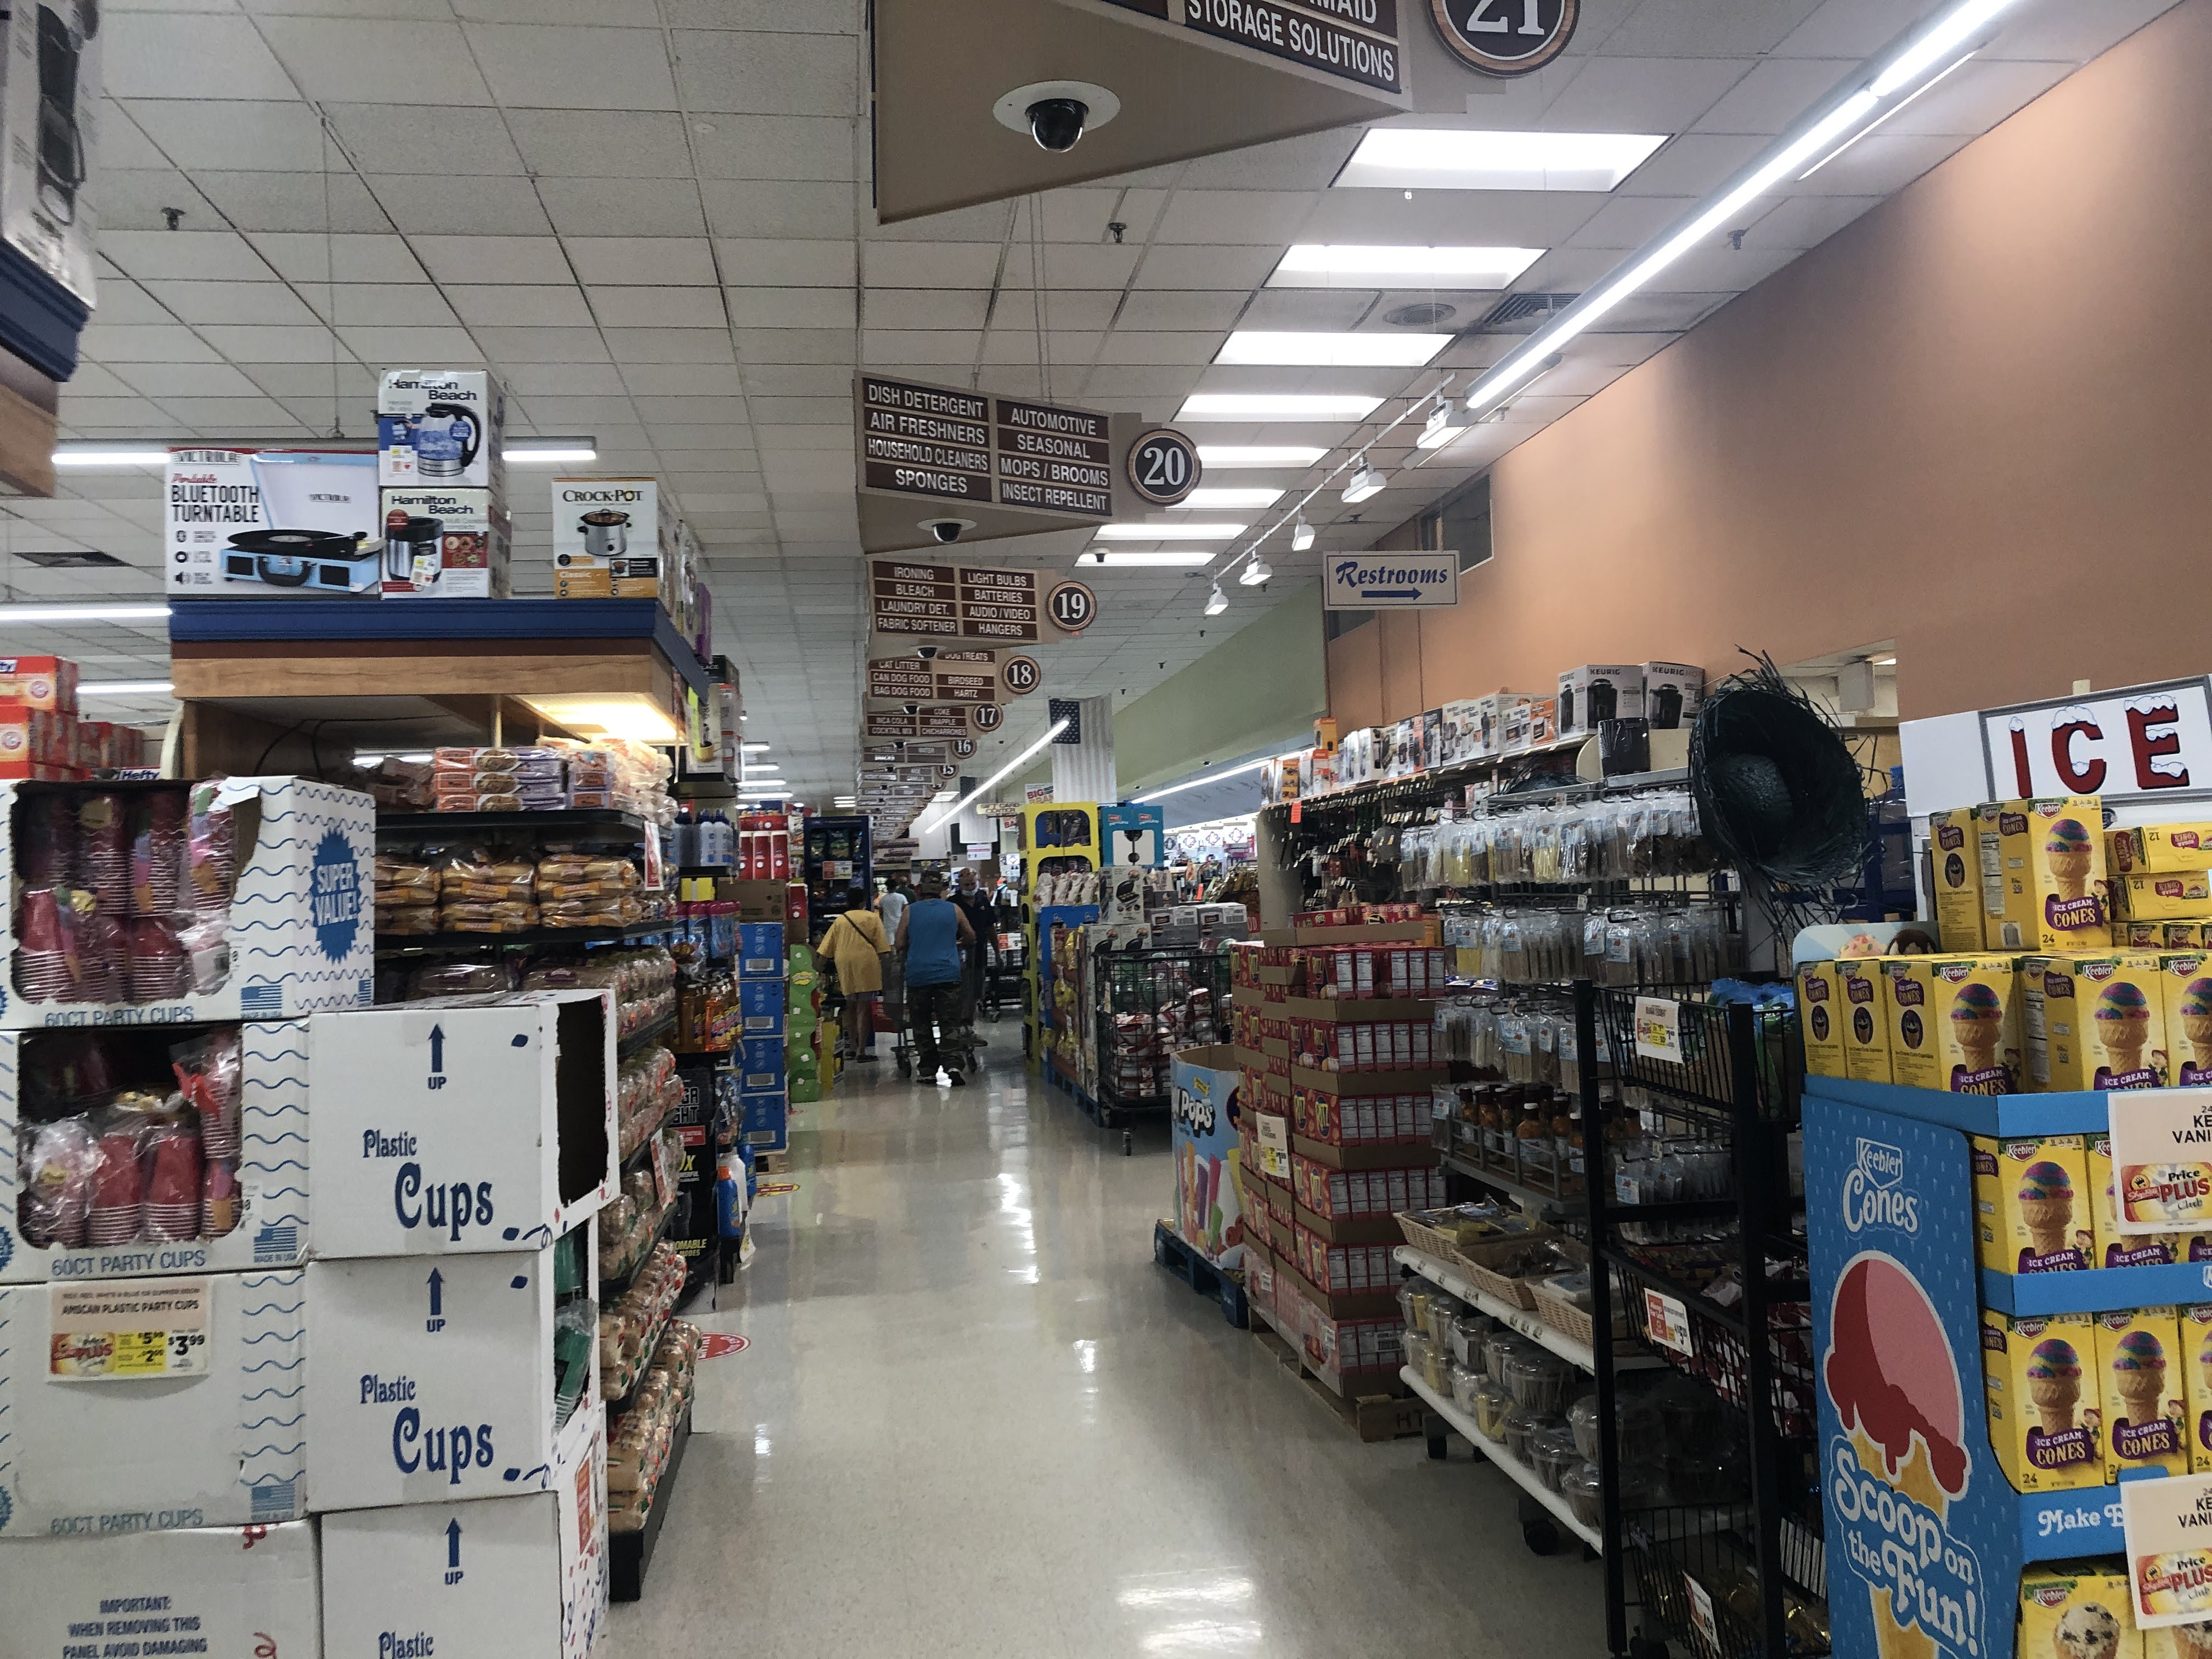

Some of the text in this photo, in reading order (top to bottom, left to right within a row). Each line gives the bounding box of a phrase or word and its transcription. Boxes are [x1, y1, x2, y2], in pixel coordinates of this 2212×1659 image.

[1189, 0, 1394, 82] STORAGE SOLUTIONS
[428, 390, 477, 400] Beach
[869, 384, 984, 417] DISH DETERGENT
[870, 412, 985, 444] AIR FRESHNERS
[1011, 408, 1096, 436] AUTOMOTIVE
[1017, 434, 1091, 459] SEASONAL
[868, 438, 988, 471] HOUSEHOLD CLEANERS
[1001, 457, 1108, 487] MOPS BROOMS
[1143, 447, 1186, 486] 20
[895, 469, 968, 493] SPONGES
[171, 485, 259, 503] BLUETOOTH
[391, 495, 456, 505] Hamilton
[1002, 483, 1106, 510] INSECT REPELLENT
[171, 505, 259, 522] TURNTABLE
[428, 505, 473, 515] Beach
[894, 567, 934, 580] IRONING
[967, 572, 1027, 586] LIGHT BULBS
[1336, 561, 1448, 588] Restrooms
[896, 584, 934, 597] BLEACH
[974, 590, 1023, 603] BATTERIES
[881, 600, 950, 615] LAUNDRY DET.
[969, 607, 1030, 620] AUDIO VIDEO
[1058, 593, 1086, 619] 19
[878, 617, 956, 633] FABRIC SOFTENER
[978, 623, 1023, 636] HANGERS
[962, 652, 988, 661] TREATS
[895, 662, 921, 670] LITTER
[1652, 666, 1685, 676] KEURIG
[873, 673, 930, 683] CAN DOG FOOD
[947, 676, 984, 685] BIRDSEED
[1012, 664, 1032, 685] 18
[874, 686, 931, 696] BAG DOG FOOD
[954, 689, 978, 697] HARTZ
[979, 708, 995, 724] 17
[957, 740, 971, 754] 16
[2009, 695, 2191, 800] ICE
[122, 770, 160, 780] Hefty
[2037, 803, 2061, 813] Keebler
[2004, 822, 2024, 832] CONES
[2149, 832, 2160, 841] 12
[318, 863, 354, 894] SUPER
[2134, 881, 2145, 889] 12
[2068, 899, 2093, 911] CREAM
[2053, 908, 2096, 928] CONES
[2042, 934, 2055, 944] 24
[1940, 966, 1968, 979] Keebler
[2084, 964, 2113, 977] Keebler
[2169, 960, 2198, 973] Keebler
[92, 1009, 144, 1026] PARTY
[150, 1006, 194, 1024] CUPS
[428, 1076, 447, 1090] UP
[1960, 1070, 2002, 1084] ICE CREAM
[2103, 1072, 2149, 1086] ICE CREAM
[2191, 1072, 2204, 1081] ICE
[1181, 1091, 1213, 1130] Pops
[363, 1129, 417, 1158] Plastic
[2007, 1144, 2036, 1158] Keebler
[1858, 1140, 1902, 1176] Keebler
[2168, 1170, 2200, 1182] Price
[2160, 1177, 2210, 1203] PLUS
[395, 1163, 494, 1242] Cups
[1843, 1168, 1918, 1233] Cones
[2028, 1253, 2074, 1267] ICE CREAM
[2116, 1248, 2160, 1262] ICE CREAM
[52, 1250, 206, 1277] 60CT PARTY CUPS
[102, 1299, 200, 1314] PLASTIC PARTY CUPS
[426, 1318, 445, 1333] UP
[2015, 1321, 2045, 1334] Keebler
[2101, 1314, 2131, 1328] Keebler
[360, 1374, 416, 1403] Plastic
[2122, 1422, 2167, 1437] ICE CREAM
[393, 1407, 494, 1484] Cups
[2036, 1432, 2083, 1447] ICE CREAM
[2121, 1432, 2170, 1456] CONES
[2036, 1441, 2086, 1466] CONES
[2196, 1457, 2211, 1466] 24
[2022, 1474, 2038, 1484] 24
[99, 1511, 153, 1532] PARTY
[157, 1508, 204, 1528] CUPS
[1835, 1448, 1974, 1585] Scoop on
[2038, 1507, 2101, 1536] Make
[2176, 1557, 2205, 1571] Price
[444, 1572, 464, 1585] UP
[1848, 1530, 1977, 1657] the Fun!
[67, 1616, 201, 1638] WHEN REMOVING THIS
[379, 1632, 434, 1659] Plastic
